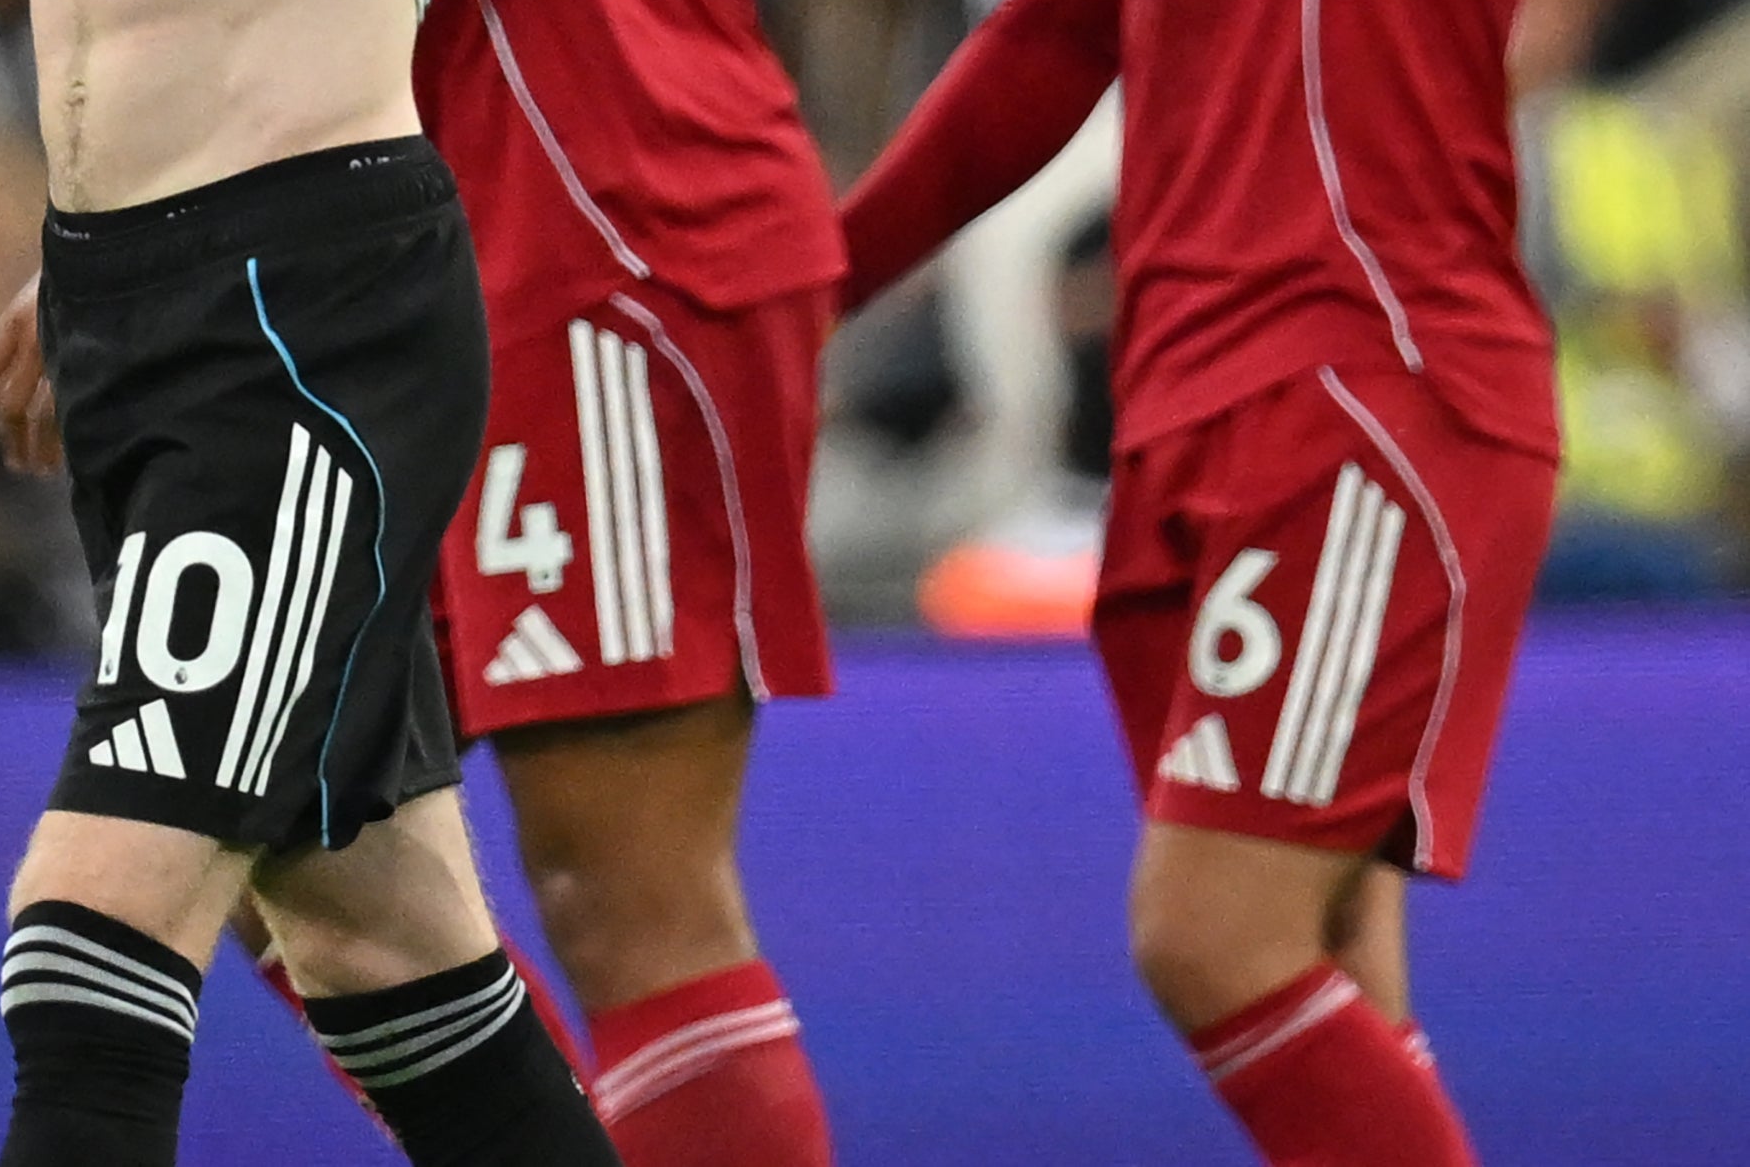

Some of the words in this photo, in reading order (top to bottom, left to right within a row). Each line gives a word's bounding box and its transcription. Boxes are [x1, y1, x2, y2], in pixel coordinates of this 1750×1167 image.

[476, 442, 573, 594] 4
[96, 530, 254, 692] 10
[1188, 547, 1283, 698] 6
